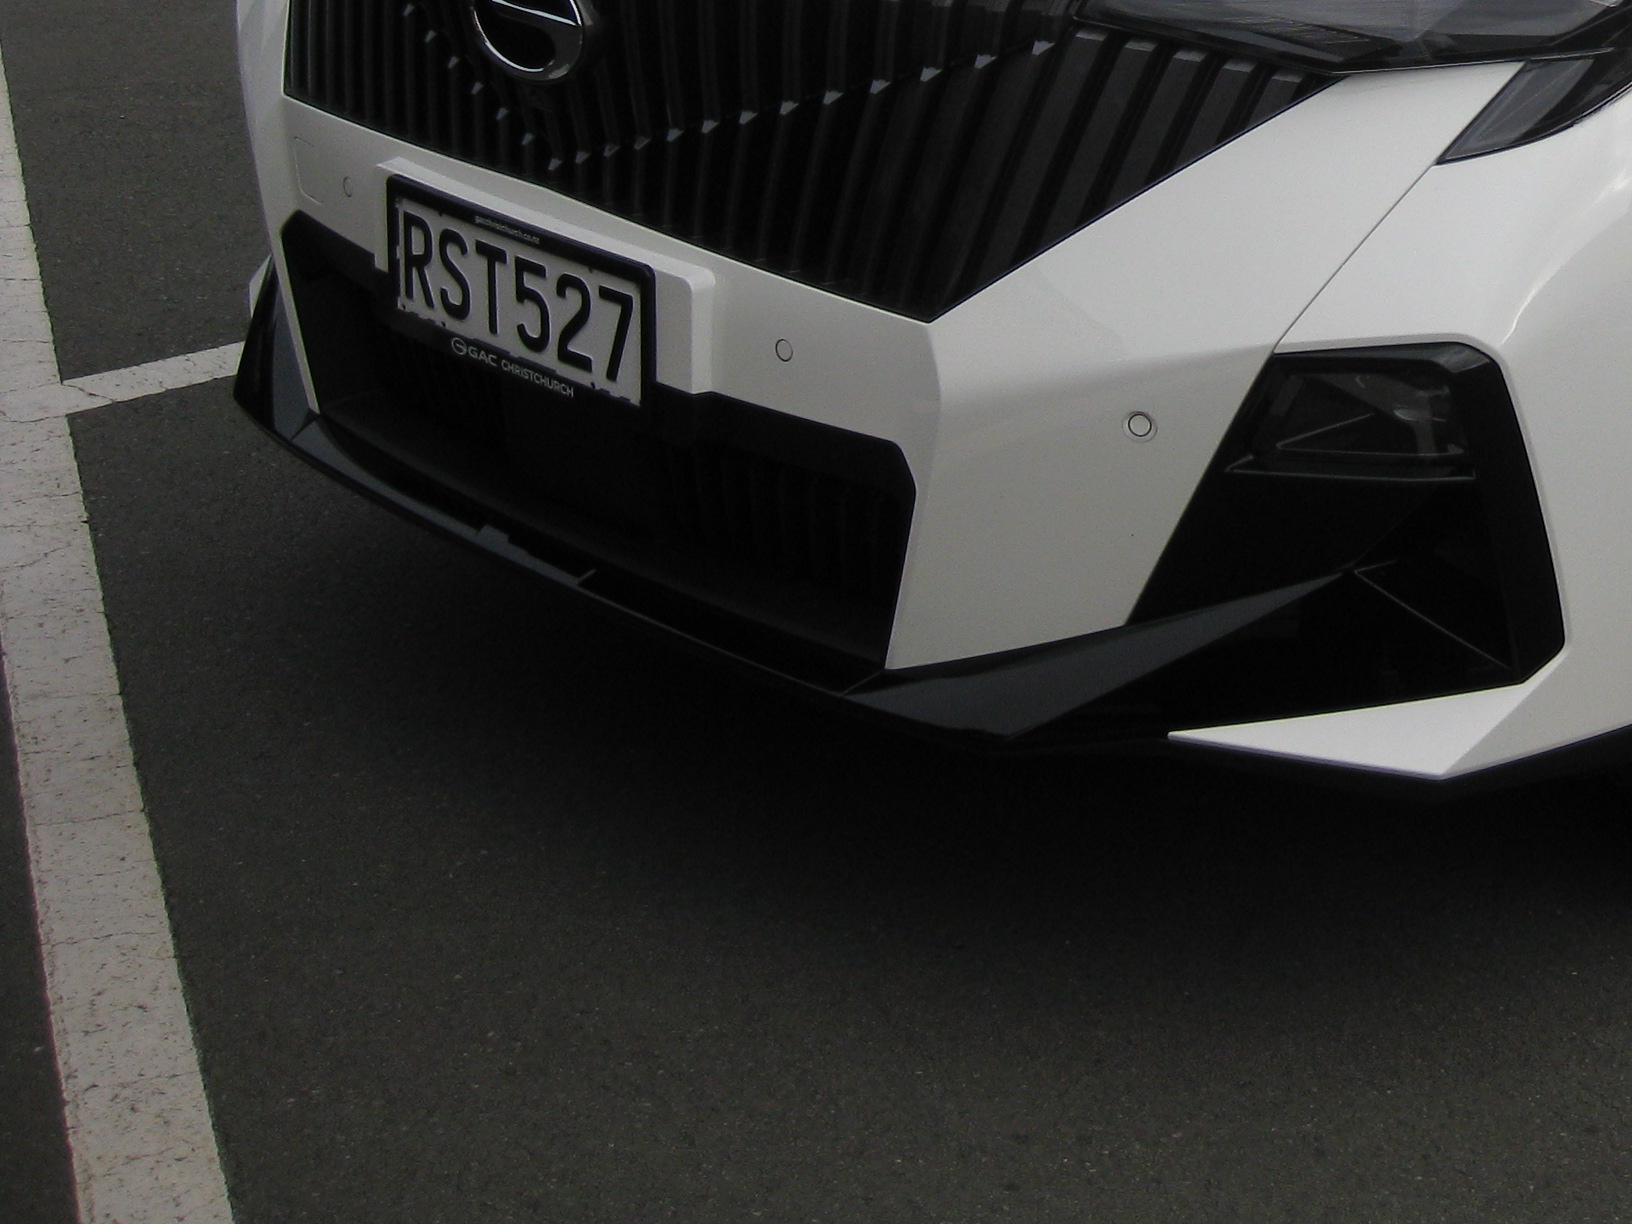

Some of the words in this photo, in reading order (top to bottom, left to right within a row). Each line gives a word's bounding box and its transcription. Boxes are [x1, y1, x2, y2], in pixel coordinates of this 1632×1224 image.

[403, 210, 634, 383] RST527
[468, 346, 498, 367] GAC
[501, 359, 575, 398] CHRISTCHURCH
